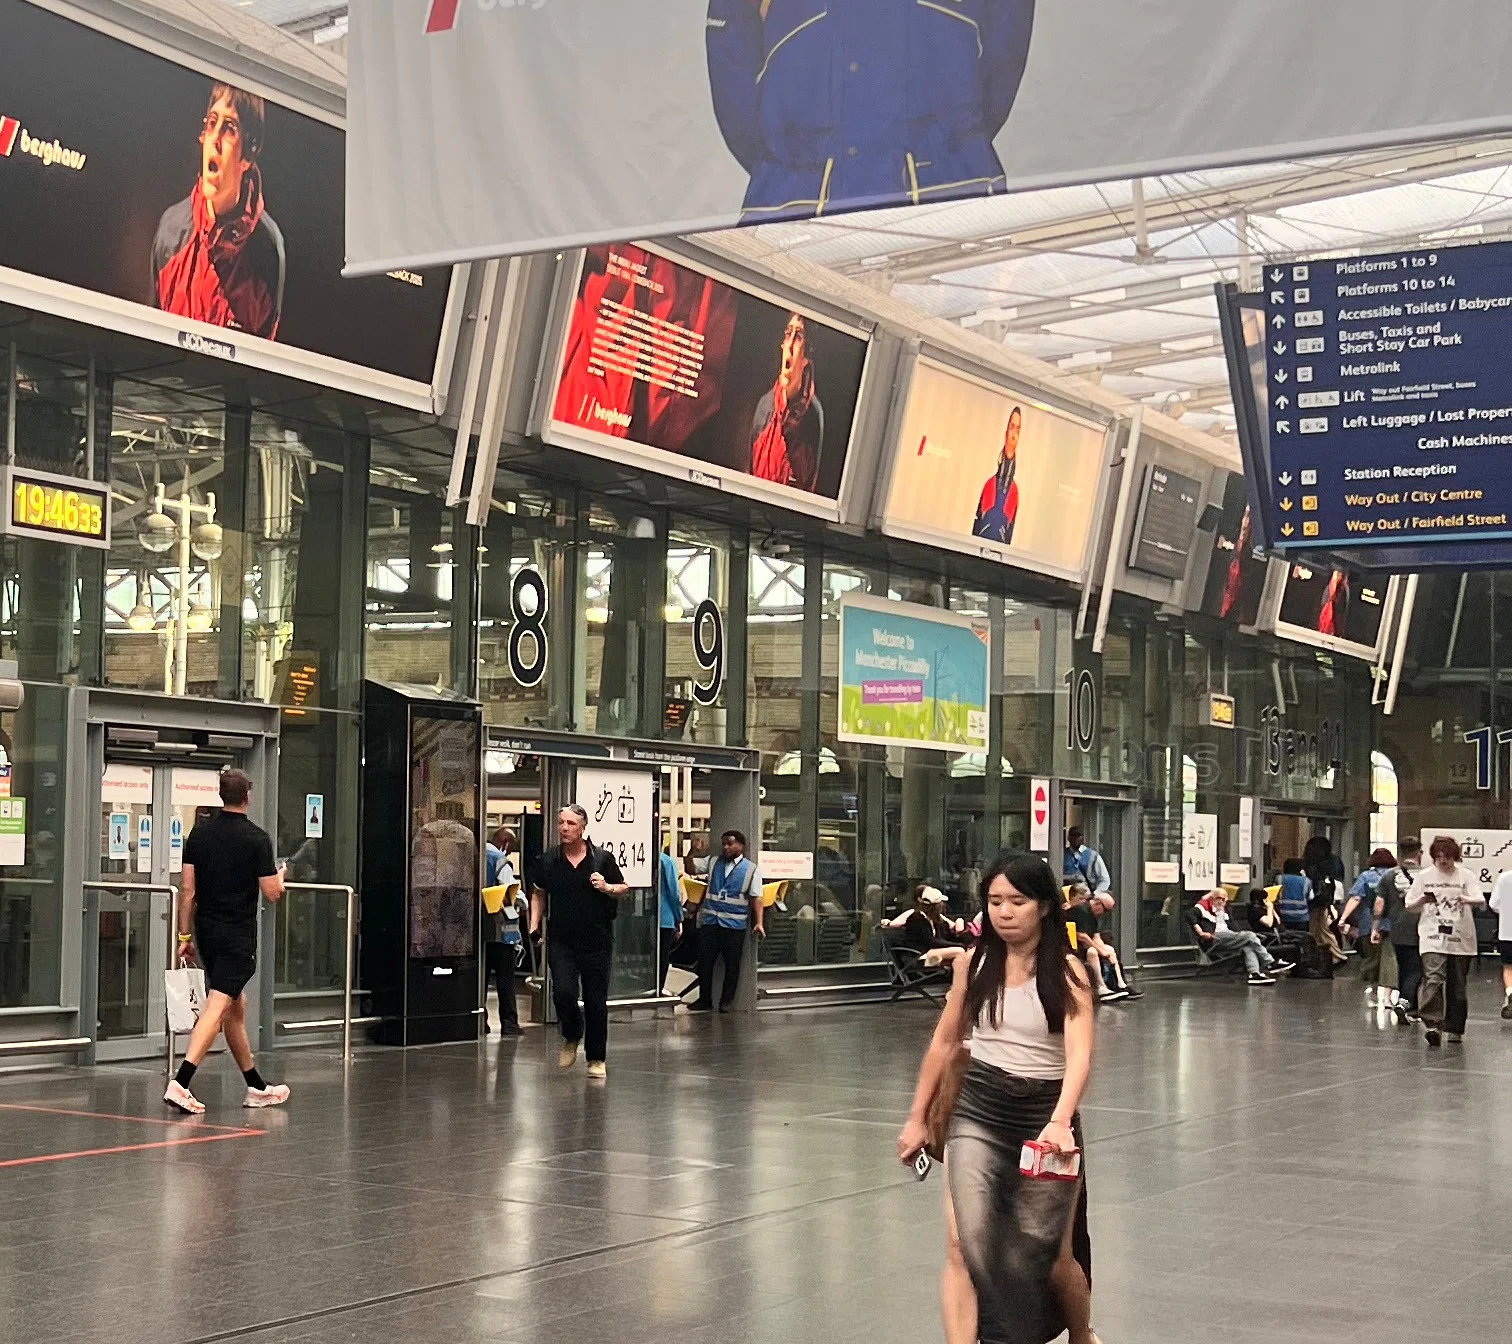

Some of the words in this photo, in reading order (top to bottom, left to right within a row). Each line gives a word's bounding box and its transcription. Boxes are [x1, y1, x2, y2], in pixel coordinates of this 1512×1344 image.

[20, 128, 87, 170] berghaus
[1336, 259, 1398, 275] Platforms
[1401, 257, 1407, 268] 1
[1411, 256, 1426, 267] to
[1429, 254, 1438, 266] 9
[1337, 282, 1398, 297] Platforms
[1401, 279, 1418, 291] 10
[1420, 278, 1436, 289] to
[1438, 275, 1456, 287] 14
[1338, 304, 1402, 321] Accessible
[1405, 300, 1447, 315] Toilets
[1339, 330, 1378, 342] Buses,
[1380, 325, 1413, 338] Taxis
[1416, 322, 1441, 334] and
[1339, 341, 1373, 355] Short
[1376, 339, 1405, 353] Stay
[1408, 337, 1429, 348] Car
[1434, 333, 1462, 346] Park
[1340, 360, 1400, 376] Metrolink
[1343, 389, 1365, 403] Lift
[1342, 415, 1368, 429] Left
[1371, 412, 1426, 428] Luggage
[1437, 409, 1464, 422] Lost
[1468, 406, 1512, 422] Proper
[1417, 436, 1449, 450] Cash
[1344, 467, 1390, 481] Station
[1393, 464, 1457, 478] Reception
[1344, 494, 1373, 508] Way
[1376, 492, 1400, 504] Out
[1411, 490, 1437, 504] City
[1439, 489, 1483, 501] Centre
[1346, 520, 1374, 534] Way
[1377, 519, 1401, 530] Out
[1411, 514, 1464, 528] Fairfield
[1466, 513, 1507, 526] Street
[507, 565, 549, 688] 8
[872, 628, 905, 649] Welcome
[906, 634, 915, 650] to
[691, 597, 724, 706] 9
[1063, 667, 1096, 753] 10
[632, 841, 645, 868] 14
[1479, 868, 1492, 883] &
